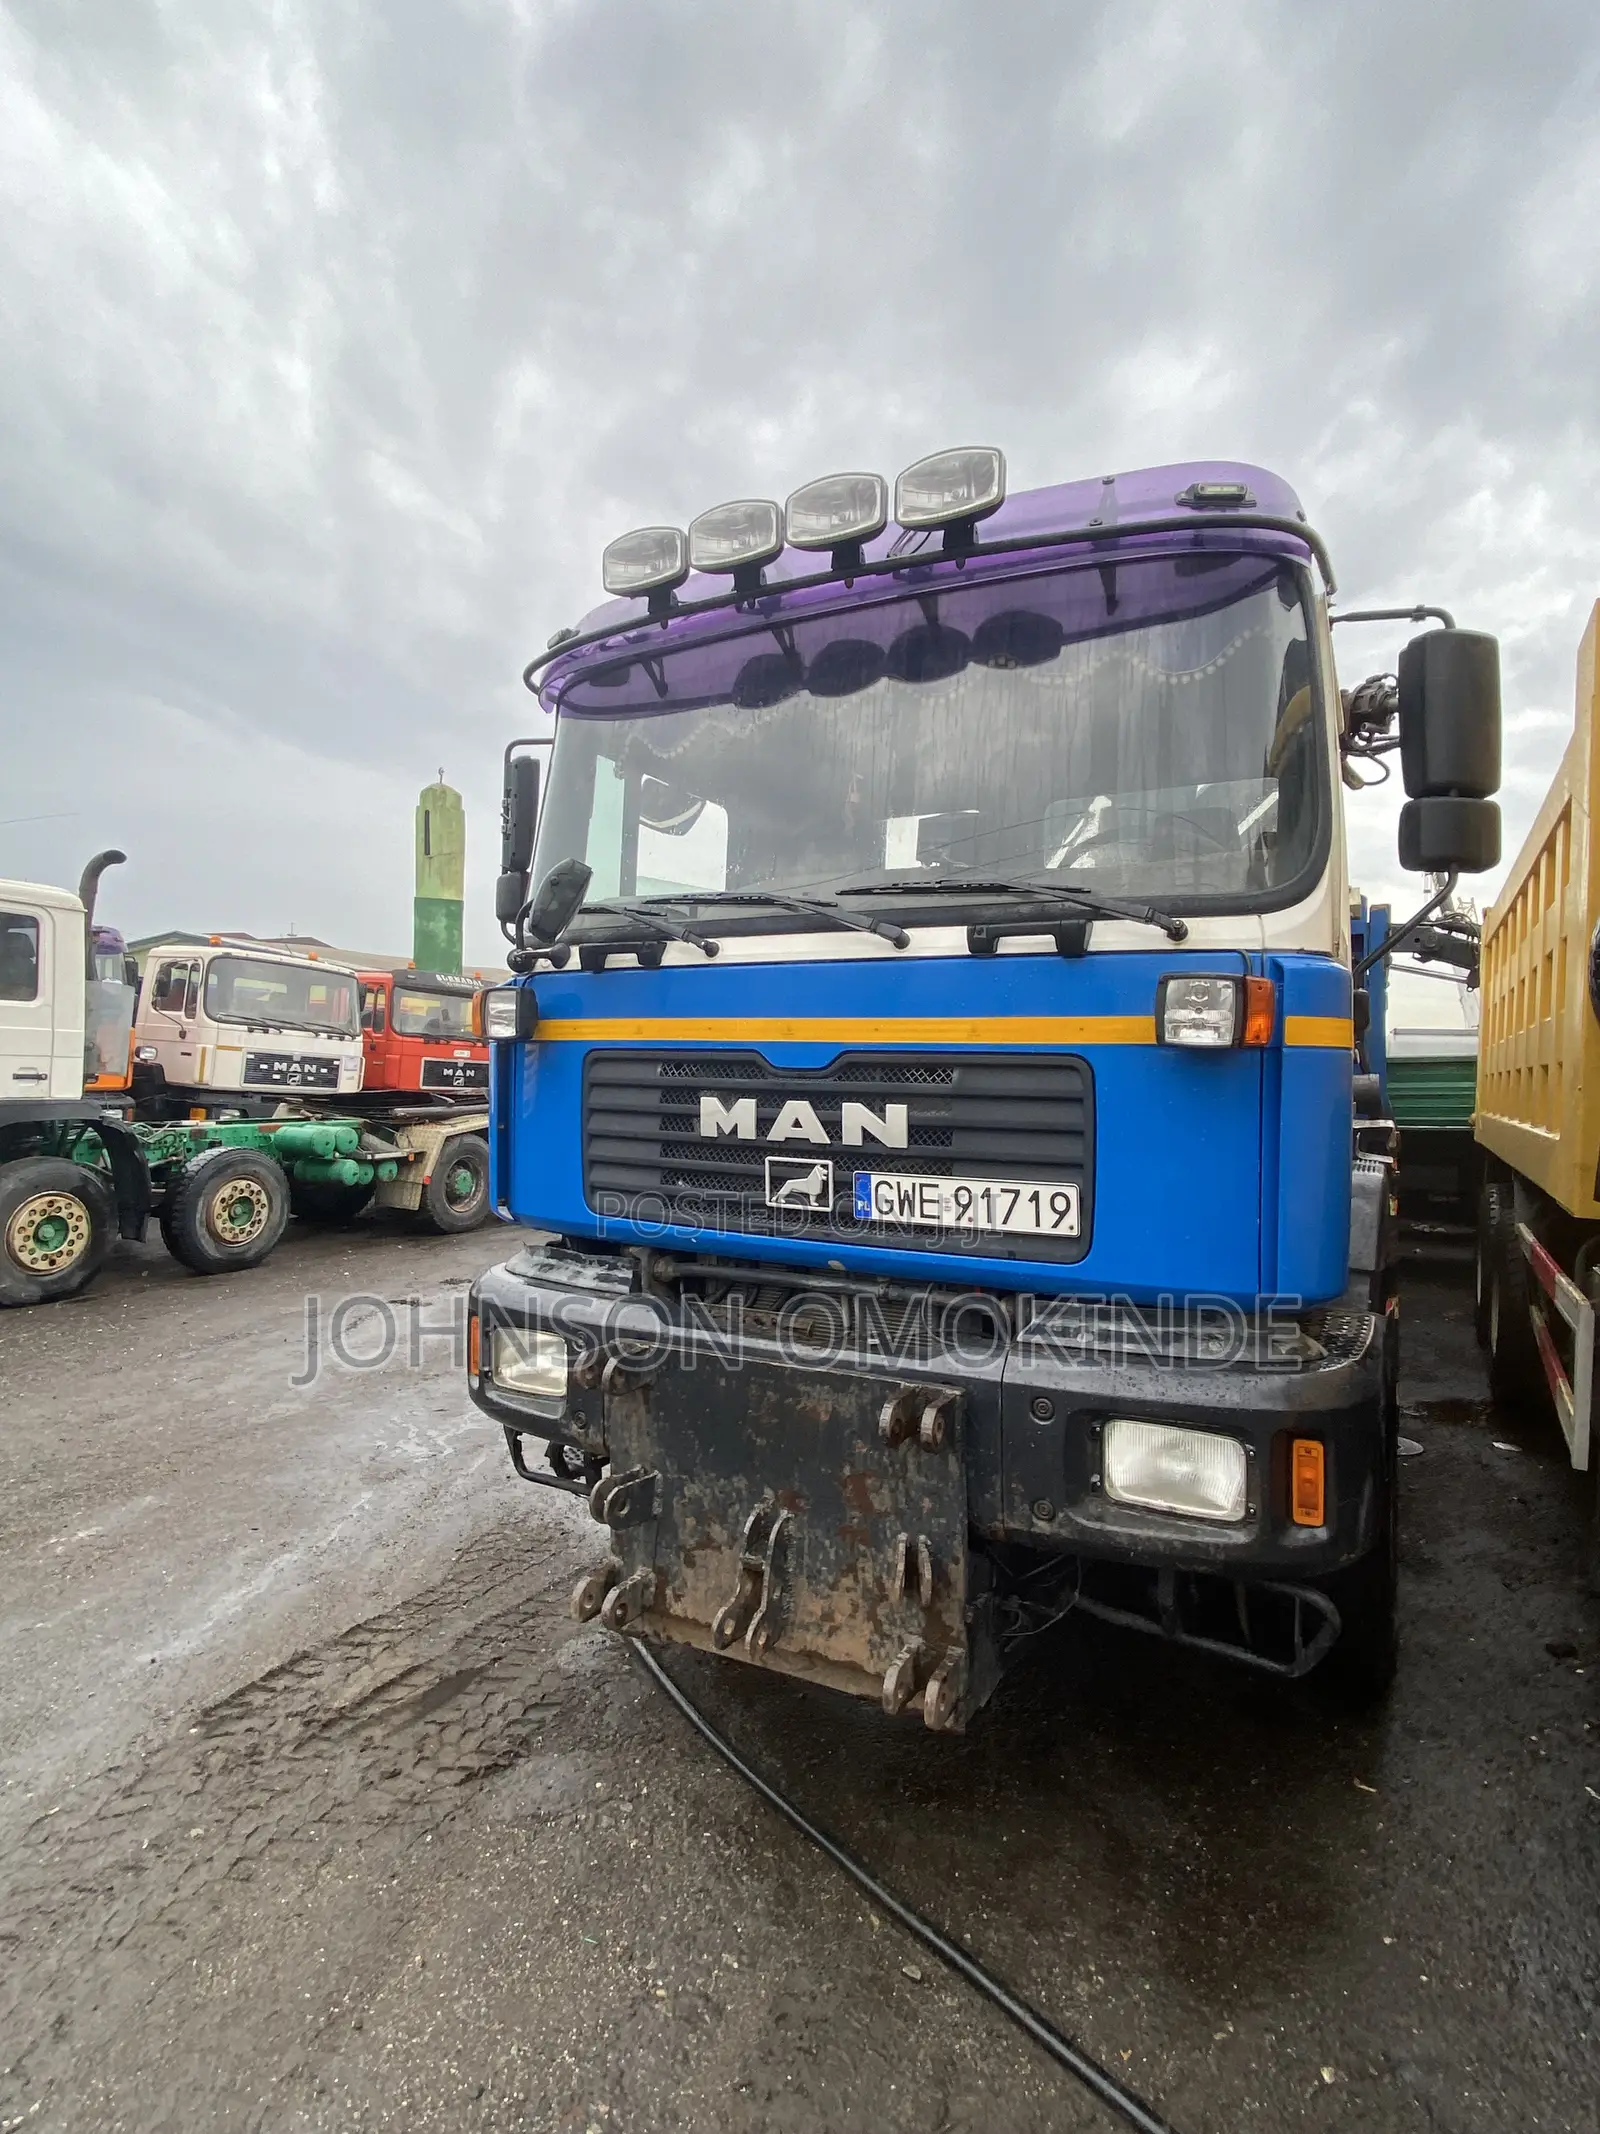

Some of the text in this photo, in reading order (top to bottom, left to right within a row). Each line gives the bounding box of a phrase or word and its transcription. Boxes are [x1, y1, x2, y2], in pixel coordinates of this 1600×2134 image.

[273, 1061, 317, 1074] MAN
[443, 1068, 476, 1078] MAN
[699, 1095, 909, 1149] MAN
[857, 1200, 871, 1212] PL
[873, 1179, 1072, 1229] GWE 91719
